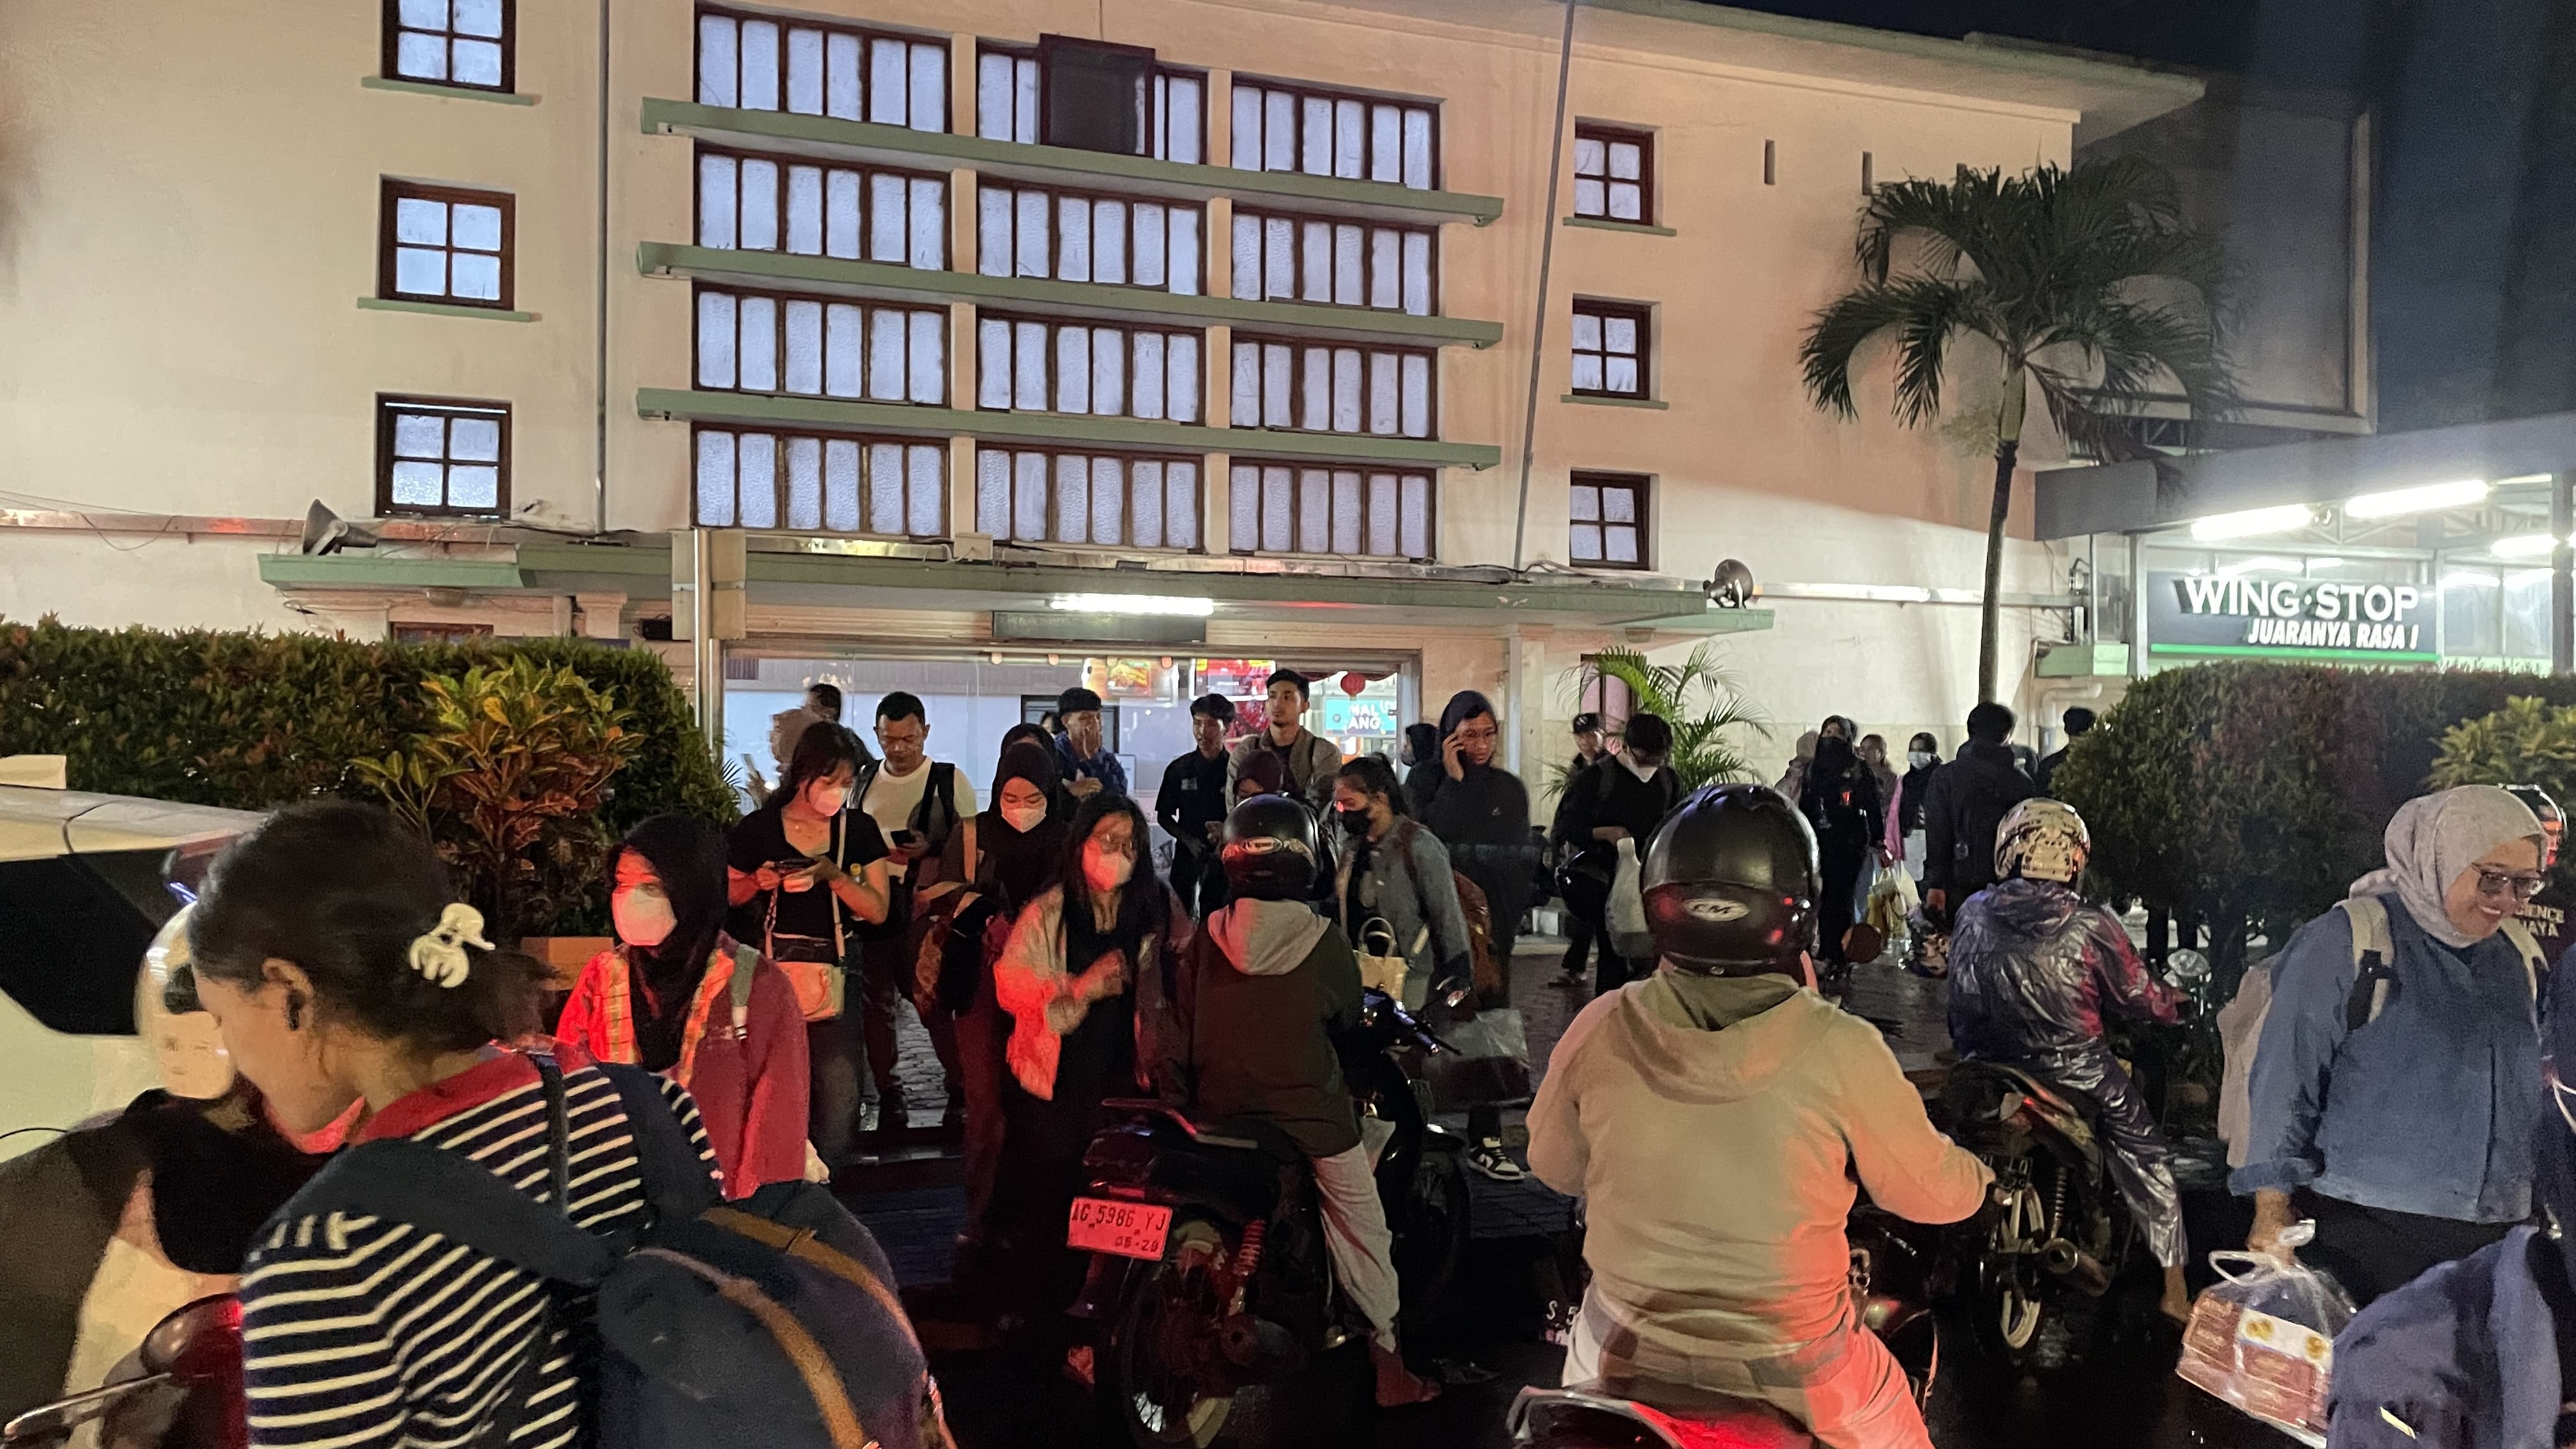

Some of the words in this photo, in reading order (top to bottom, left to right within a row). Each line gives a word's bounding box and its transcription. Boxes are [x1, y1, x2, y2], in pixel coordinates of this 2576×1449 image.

[2248, 618, 2351, 647] JUARANYA
[2356, 622, 2406, 650] RASA
[1348, 715, 1381, 730] ANG
[1071, 1204, 1091, 1222] AG
[1096, 1205, 1135, 1227] 5986
[1146, 1212, 1166, 1230] YJ
[1545, 1300, 1558, 1321] S
